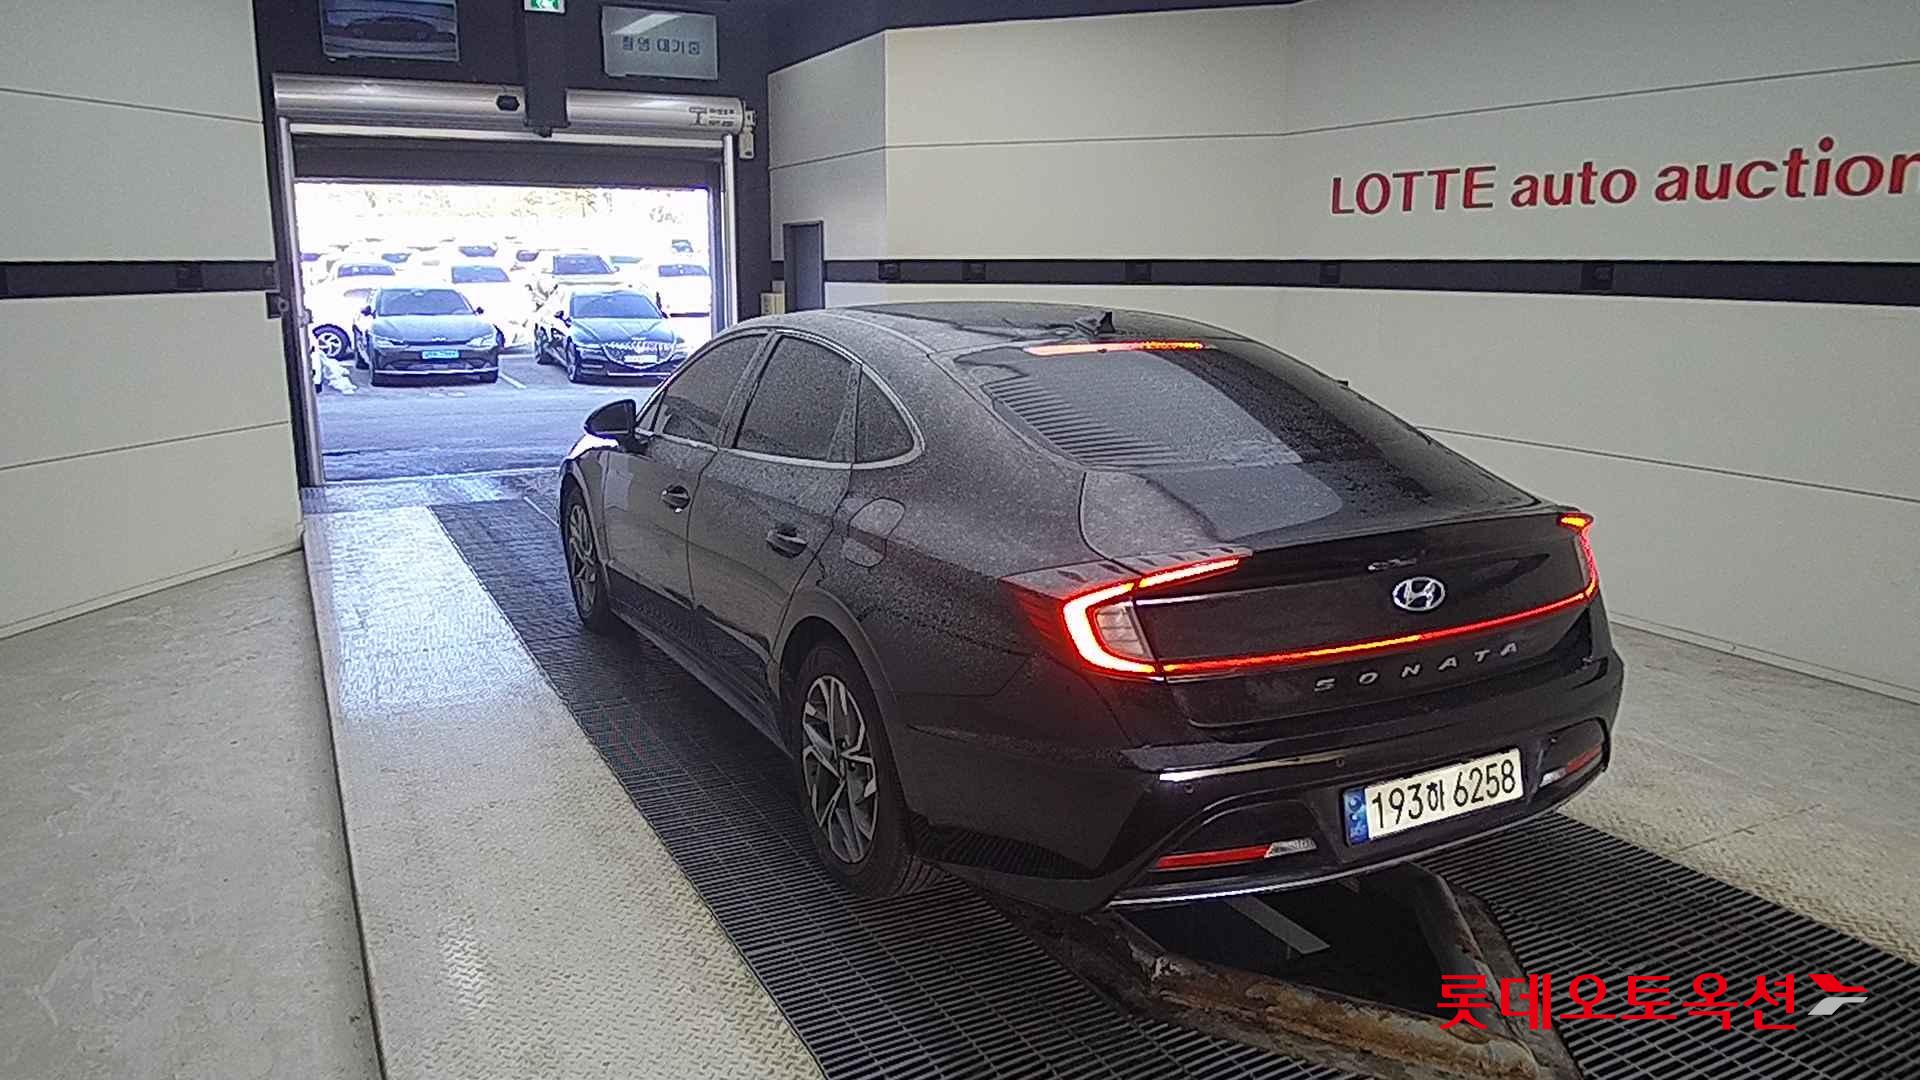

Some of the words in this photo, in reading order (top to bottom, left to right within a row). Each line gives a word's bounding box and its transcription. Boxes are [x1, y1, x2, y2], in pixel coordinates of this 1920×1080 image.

[1330, 165, 1497, 215] LOTTE
[1510, 161, 1637, 208] auto
[1313, 642, 1518, 692] SONATA
[1372, 780, 1445, 829] 193하
[1453, 758, 1516, 808] 6258
